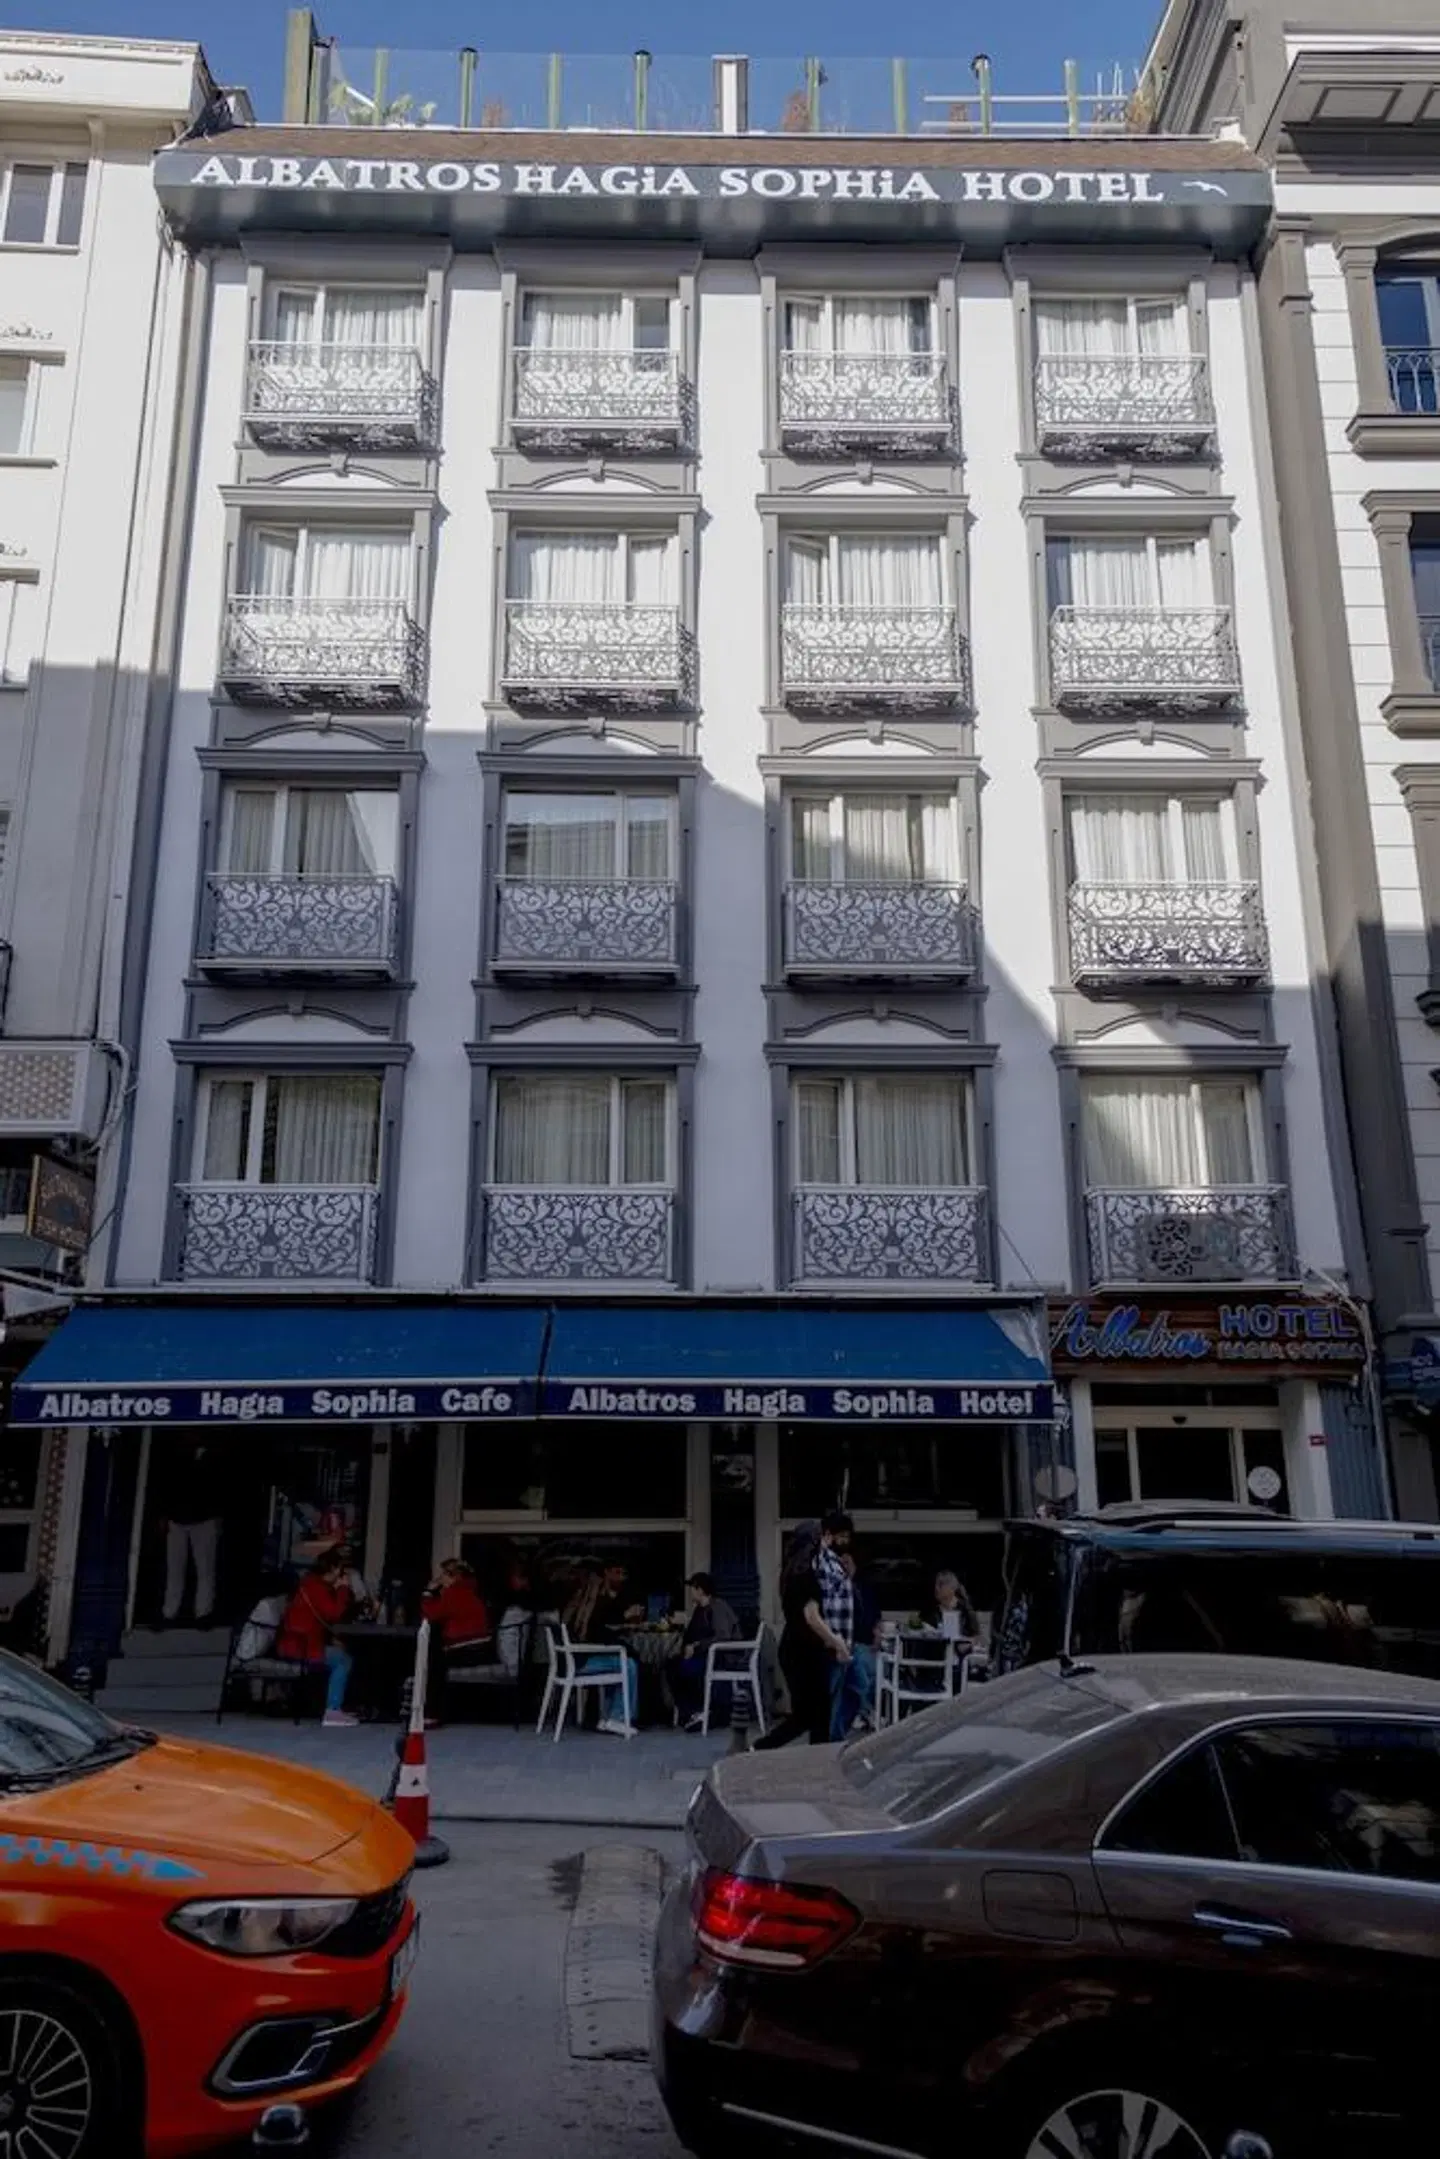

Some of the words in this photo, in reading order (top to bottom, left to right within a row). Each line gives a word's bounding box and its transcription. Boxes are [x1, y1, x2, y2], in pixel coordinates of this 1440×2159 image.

[190, 156, 501, 192] ALBATROS
[962, 171, 1164, 202] HOTEL
[1218, 1303, 1360, 1339] HOTEL
[39, 1393, 171, 1418] Albatros
[200, 1390, 284, 1420] Hagia
[311, 1388, 416, 1417] Sophia
[441, 1387, 511, 1412] Cafe
[569, 1387, 696, 1413] Albatros
[724, 1388, 806, 1418] Hagia
[833, 1389, 935, 1418] Sophia
[960, 1390, 1033, 1415] Hotel
